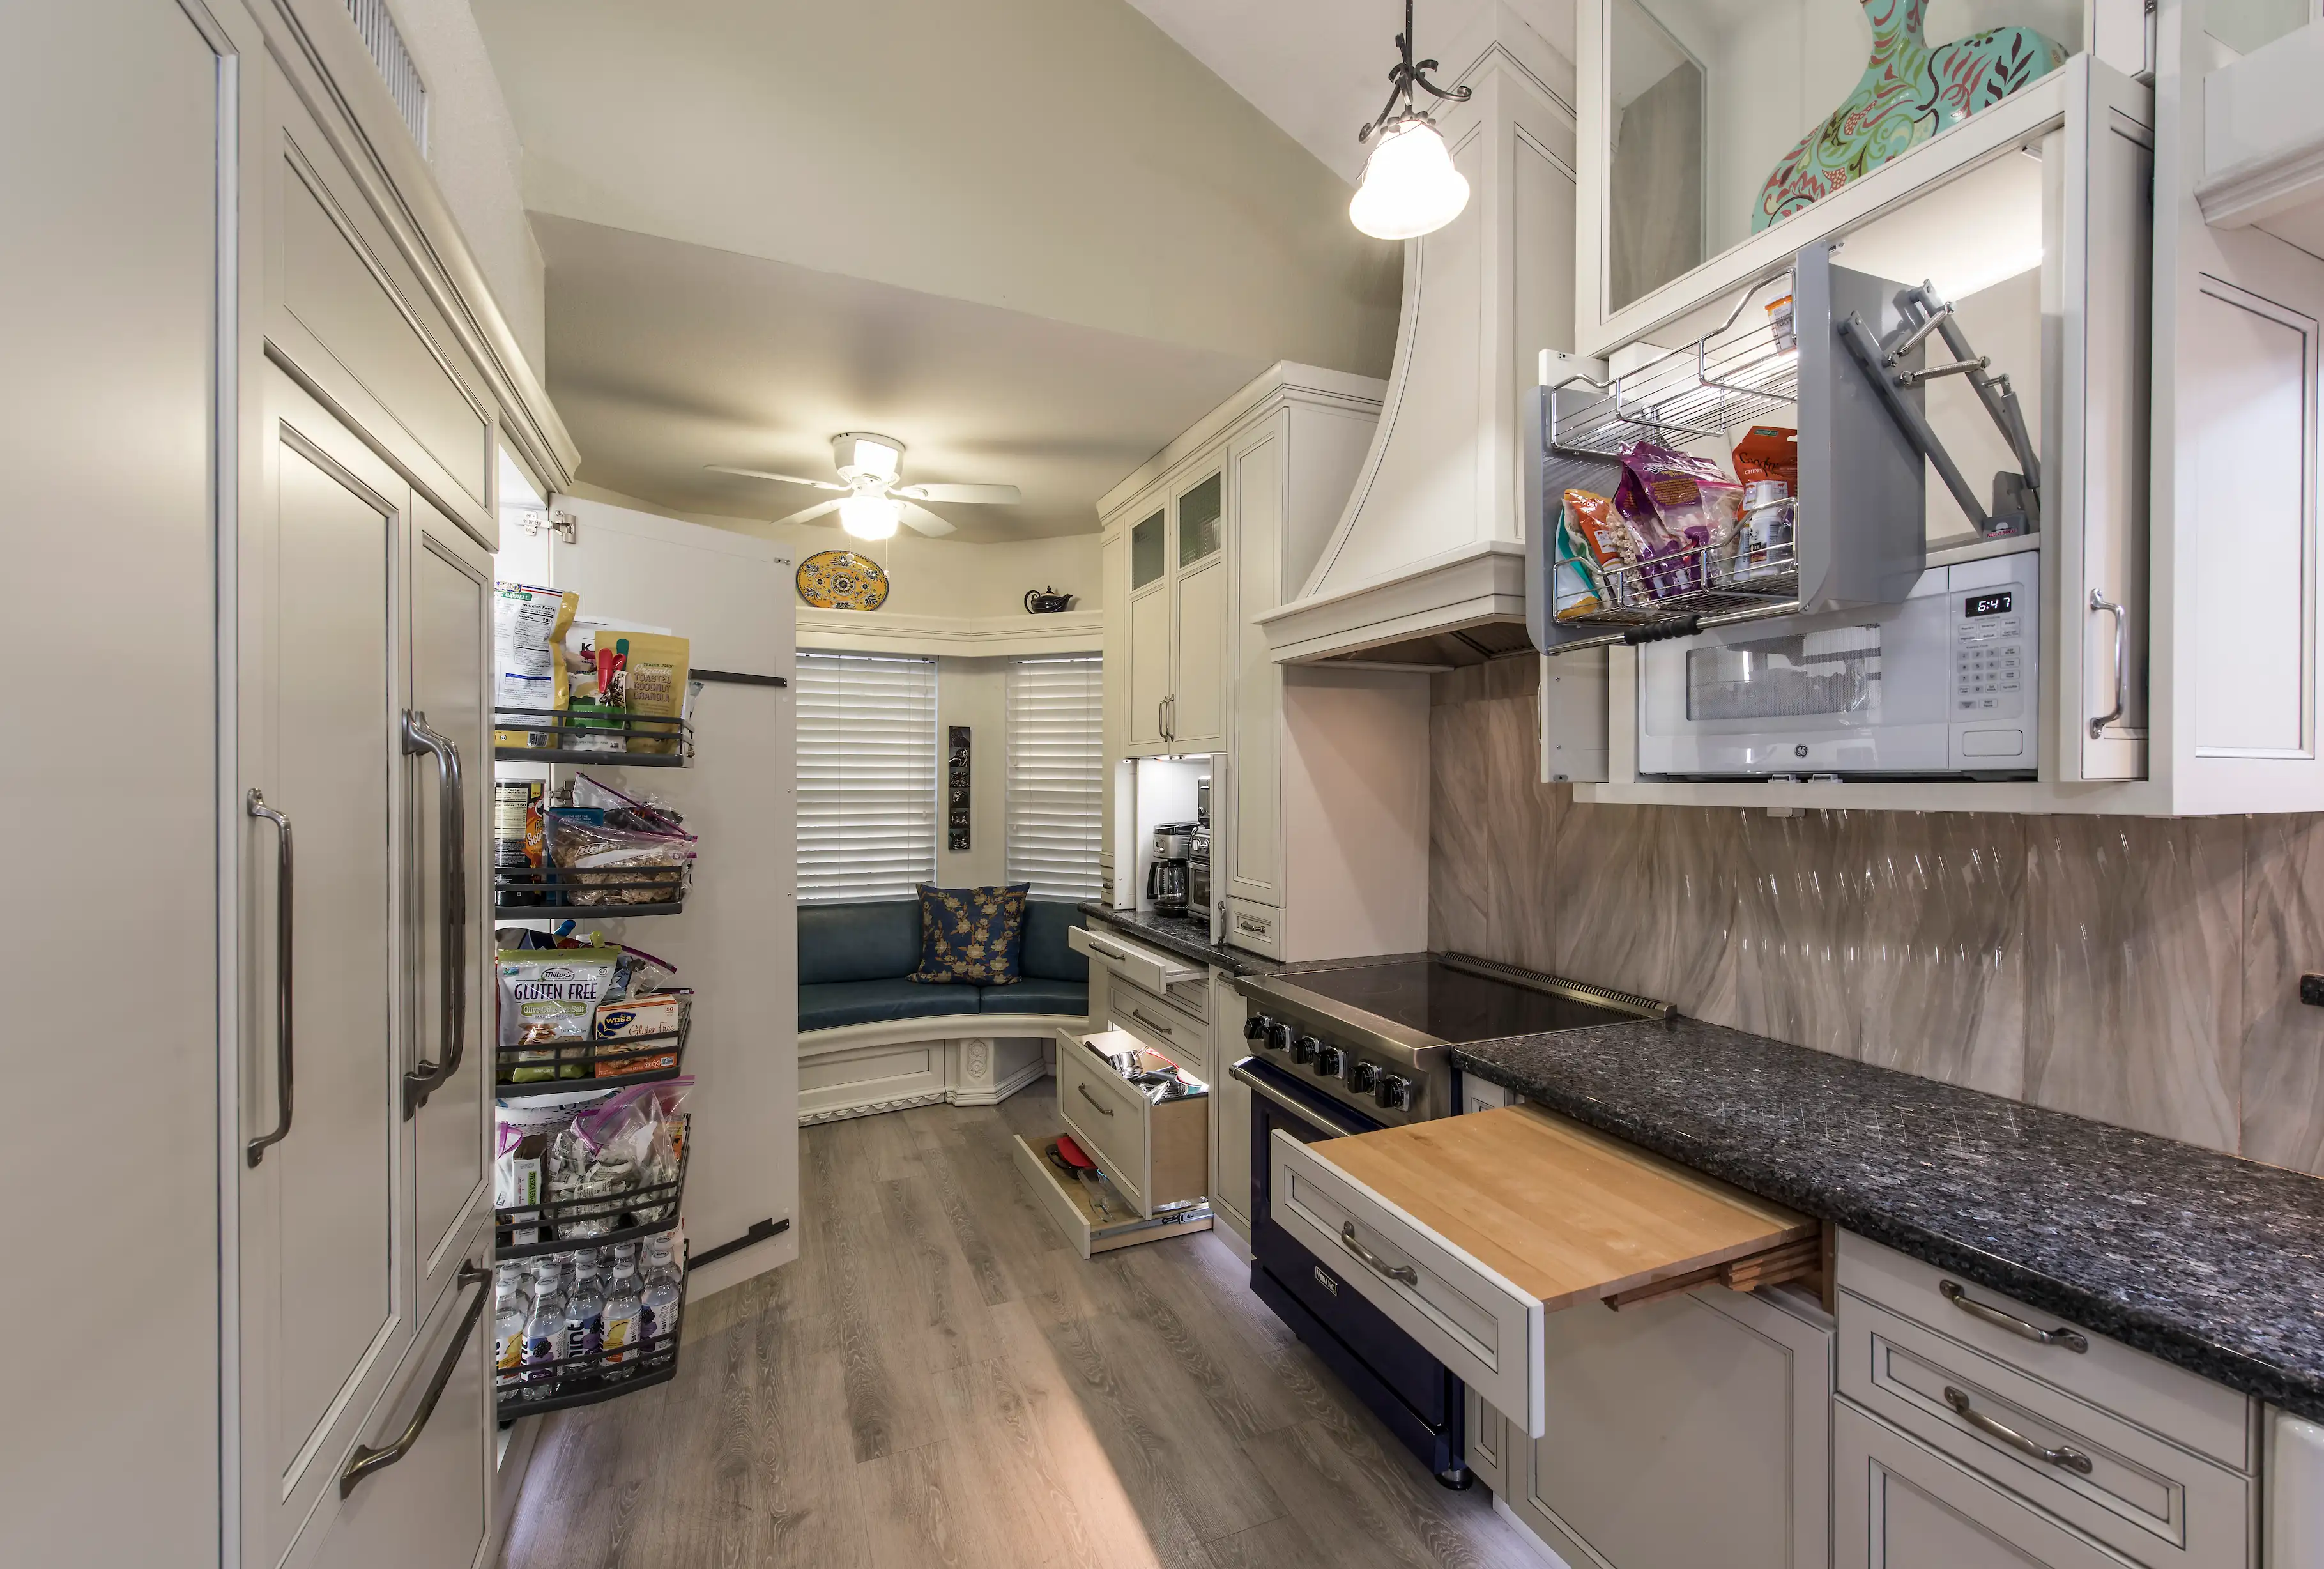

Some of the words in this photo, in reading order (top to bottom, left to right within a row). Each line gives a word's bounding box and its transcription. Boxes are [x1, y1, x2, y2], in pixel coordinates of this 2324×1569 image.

[634, 664, 672, 677] Organic
[634, 673, 672, 684] TOASTED
[634, 682, 671, 693] COCONUT
[634, 692, 670, 702] GRANOLA
[514, 983, 562, 1000] GLUTEN
[568, 983, 598, 1000] FREE
[571, 1005, 584, 1013] Salt
[629, 1024, 657, 1036] Gluten
[659, 1022, 675, 1033] Free
[1317, 1269, 1335, 1292] VIKING
